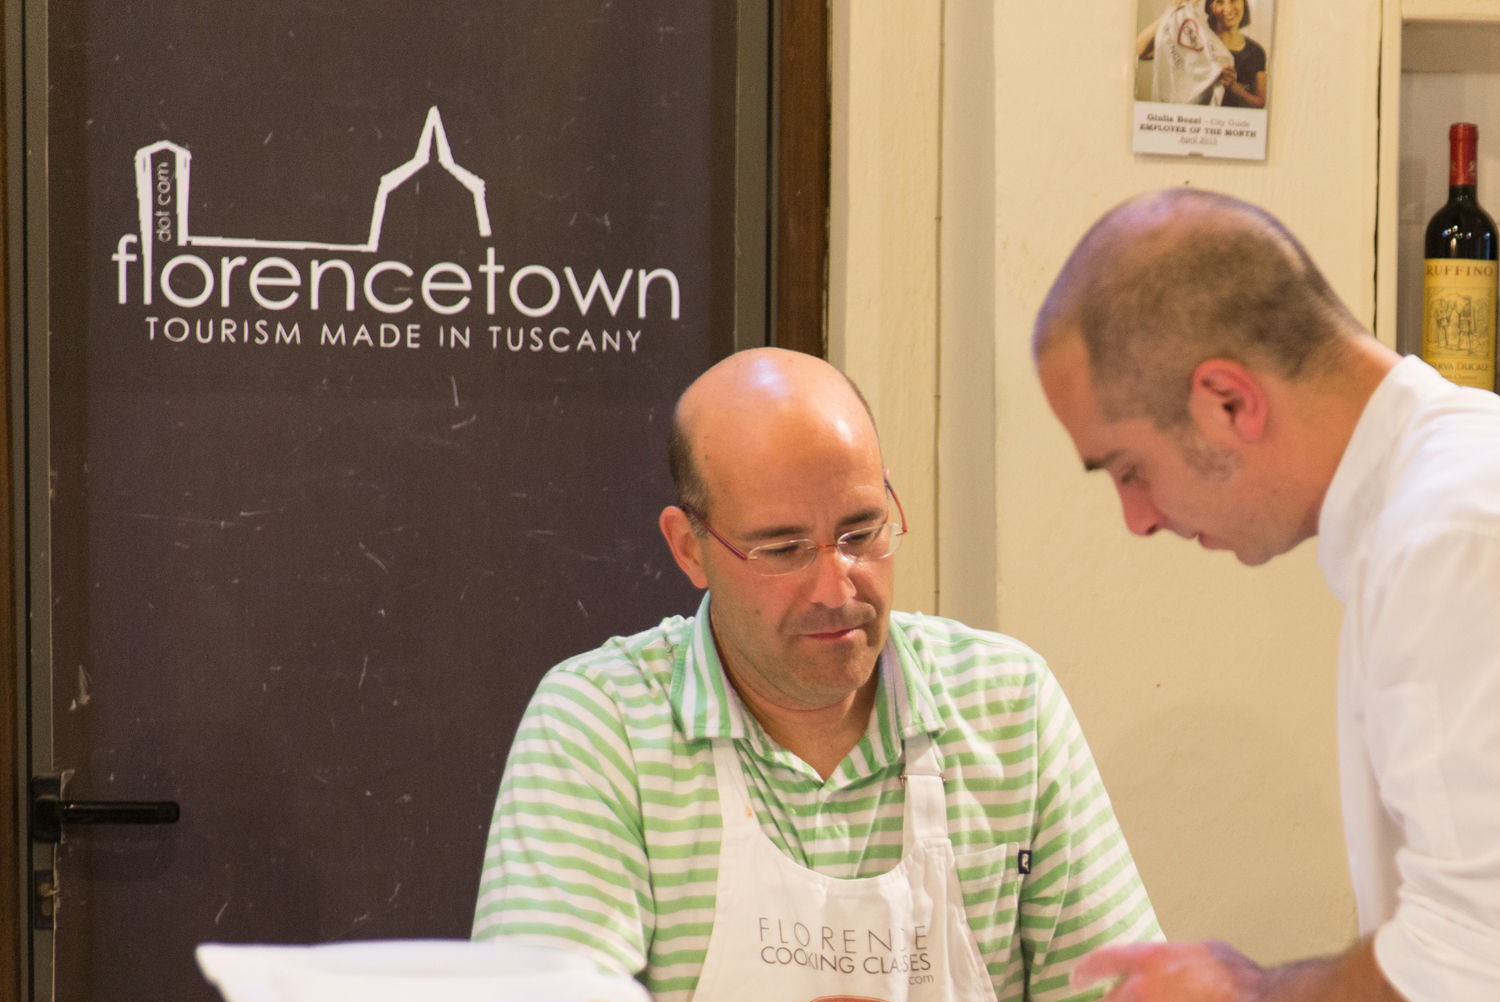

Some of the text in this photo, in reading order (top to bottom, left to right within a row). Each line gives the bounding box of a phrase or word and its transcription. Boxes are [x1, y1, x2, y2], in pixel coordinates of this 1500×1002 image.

[1139, 123, 1257, 137] EMPLOYEE OF THE MONTH
[154, 161, 172, 243] dot com
[111, 233, 681, 321] florencetown
[1426, 265, 1494, 278] RUFFINO
[145, 316, 642, 353] TOURISM MADE IN TUSCANY
[758, 916, 928, 955] FLORENE
[760, 945, 855, 974] COOKING
